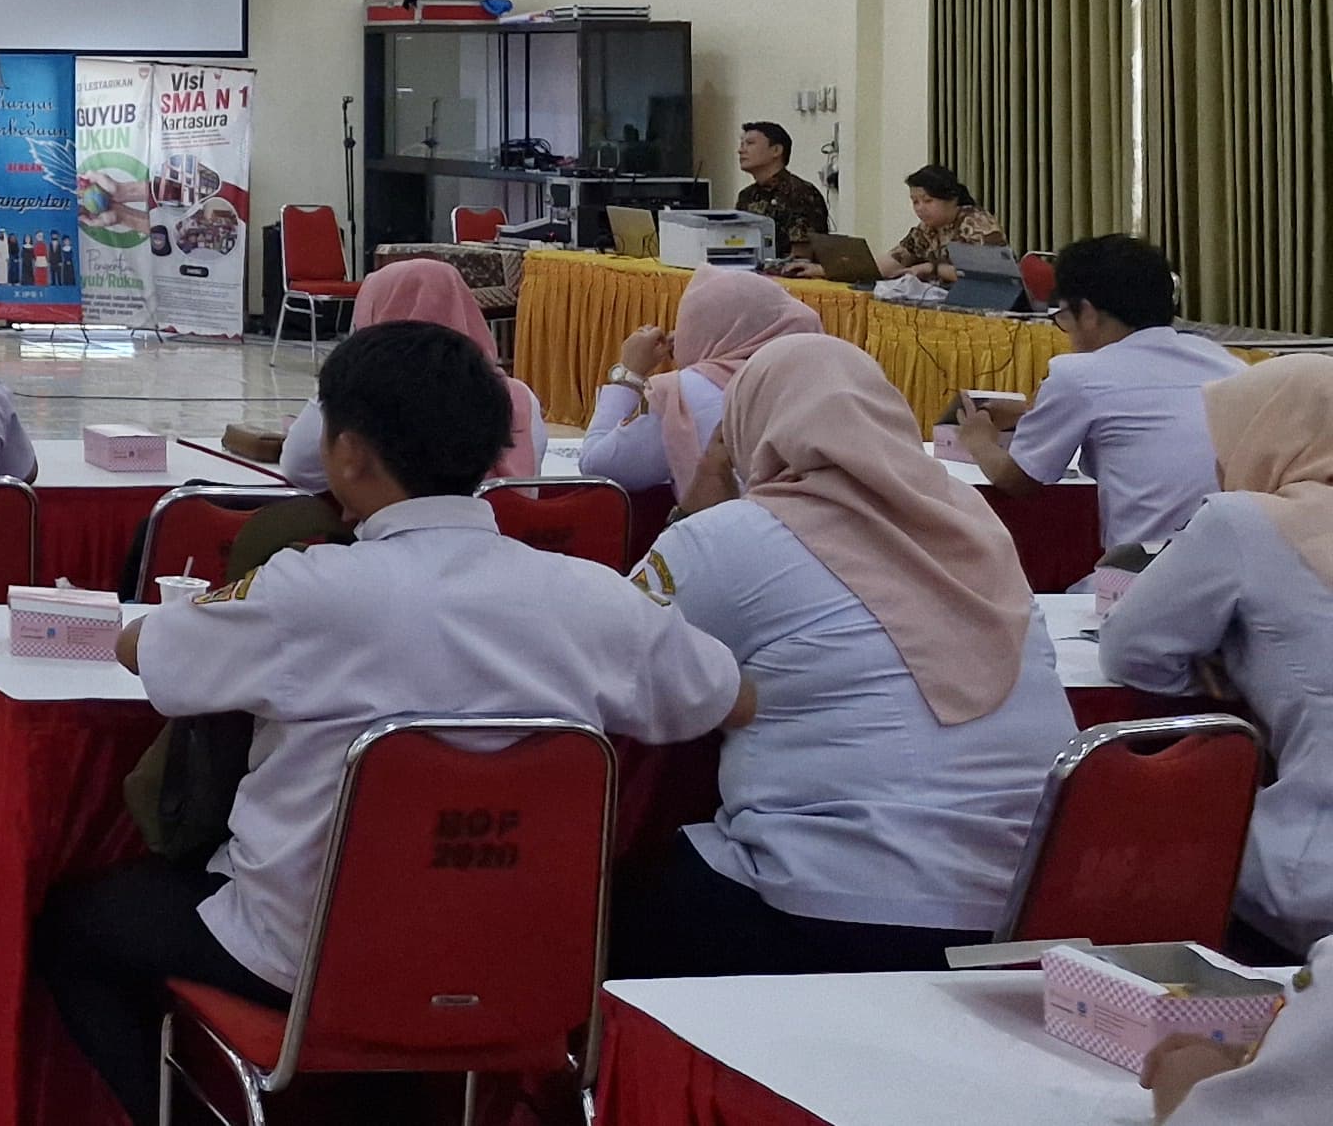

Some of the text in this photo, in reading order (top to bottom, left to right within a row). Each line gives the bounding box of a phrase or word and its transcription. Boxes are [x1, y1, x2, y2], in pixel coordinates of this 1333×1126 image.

[171, 70, 205, 92] Visi
[161, 85, 250, 114] SMA N 1
[76, 103, 136, 128] GUYUB
[161, 114, 228, 131] Kartasura
[78, 126, 131, 151] UKUN
